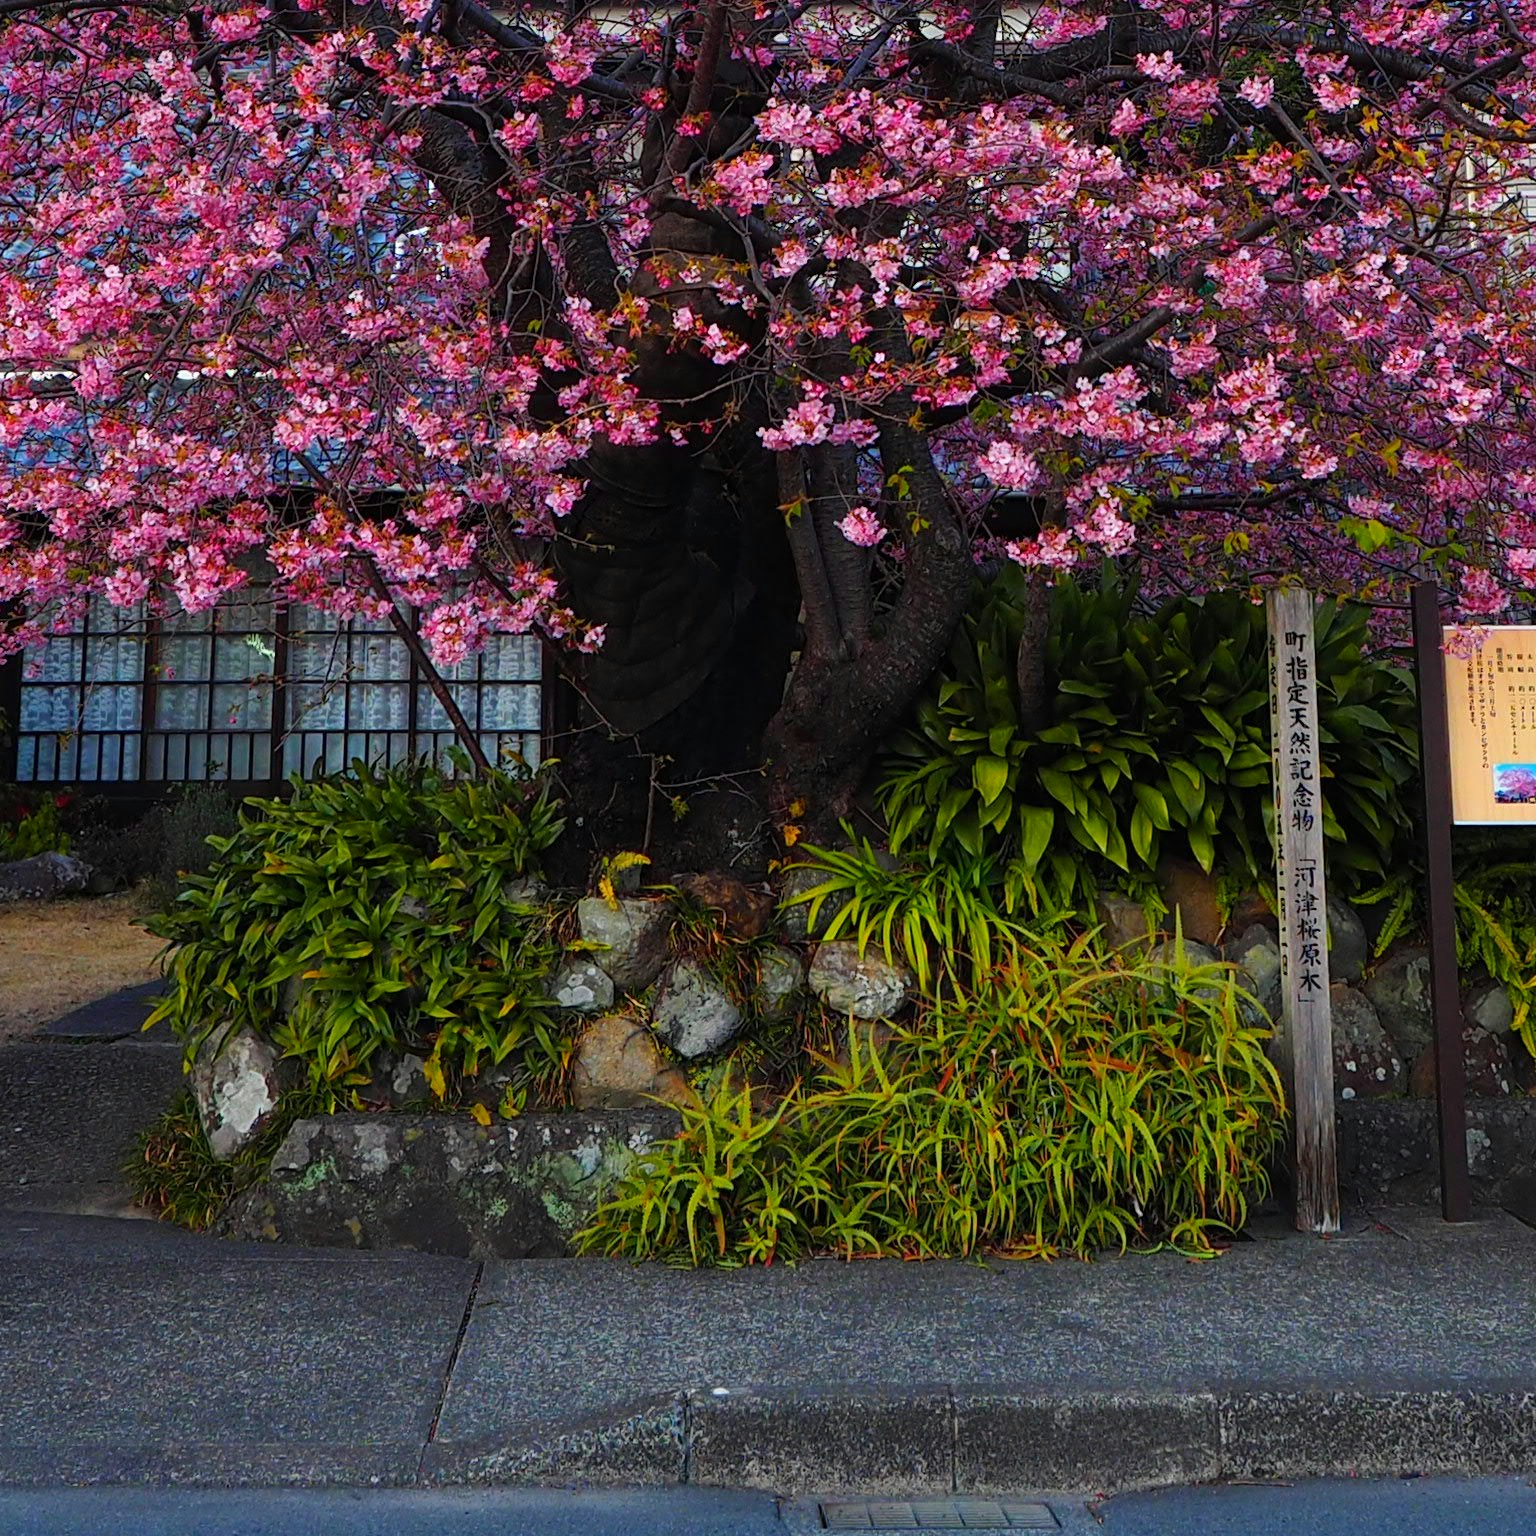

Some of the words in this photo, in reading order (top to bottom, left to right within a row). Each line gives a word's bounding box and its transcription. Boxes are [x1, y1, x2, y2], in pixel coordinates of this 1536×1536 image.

[1284, 631, 1315, 832] 町指定天然記念物
[1294, 857, 1322, 1003] 「河津桜原木」
